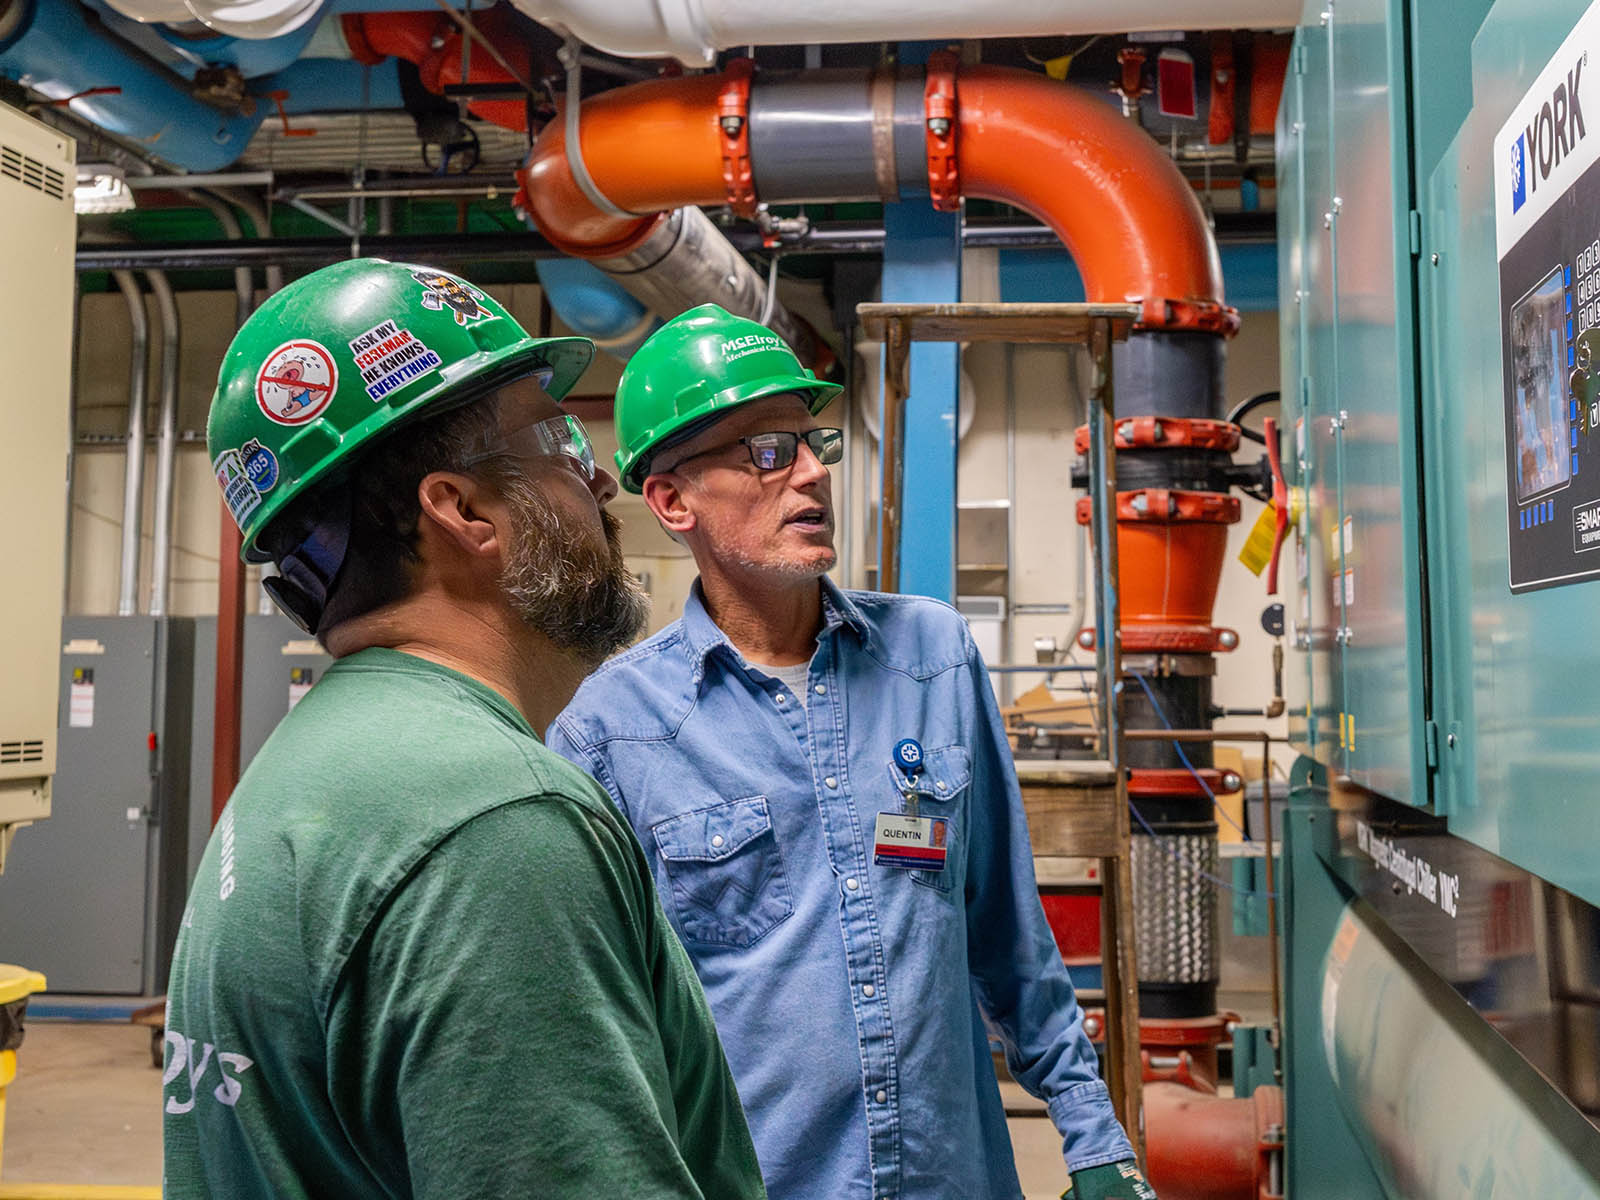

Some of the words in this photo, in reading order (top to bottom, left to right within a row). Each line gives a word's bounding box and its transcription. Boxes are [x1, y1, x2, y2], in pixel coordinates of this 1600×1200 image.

[1526, 56, 1586, 193] YORK
[351, 333, 379, 354] ASK
[375, 322, 396, 339] MY
[356, 330, 412, 369] FOREMAN
[363, 366, 383, 384] HE
[378, 342, 425, 374] KNOWS
[368, 352, 439, 400] EVERYTHING
[247, 453, 269, 480] 365
[883, 828, 922, 840] QUENTIN
